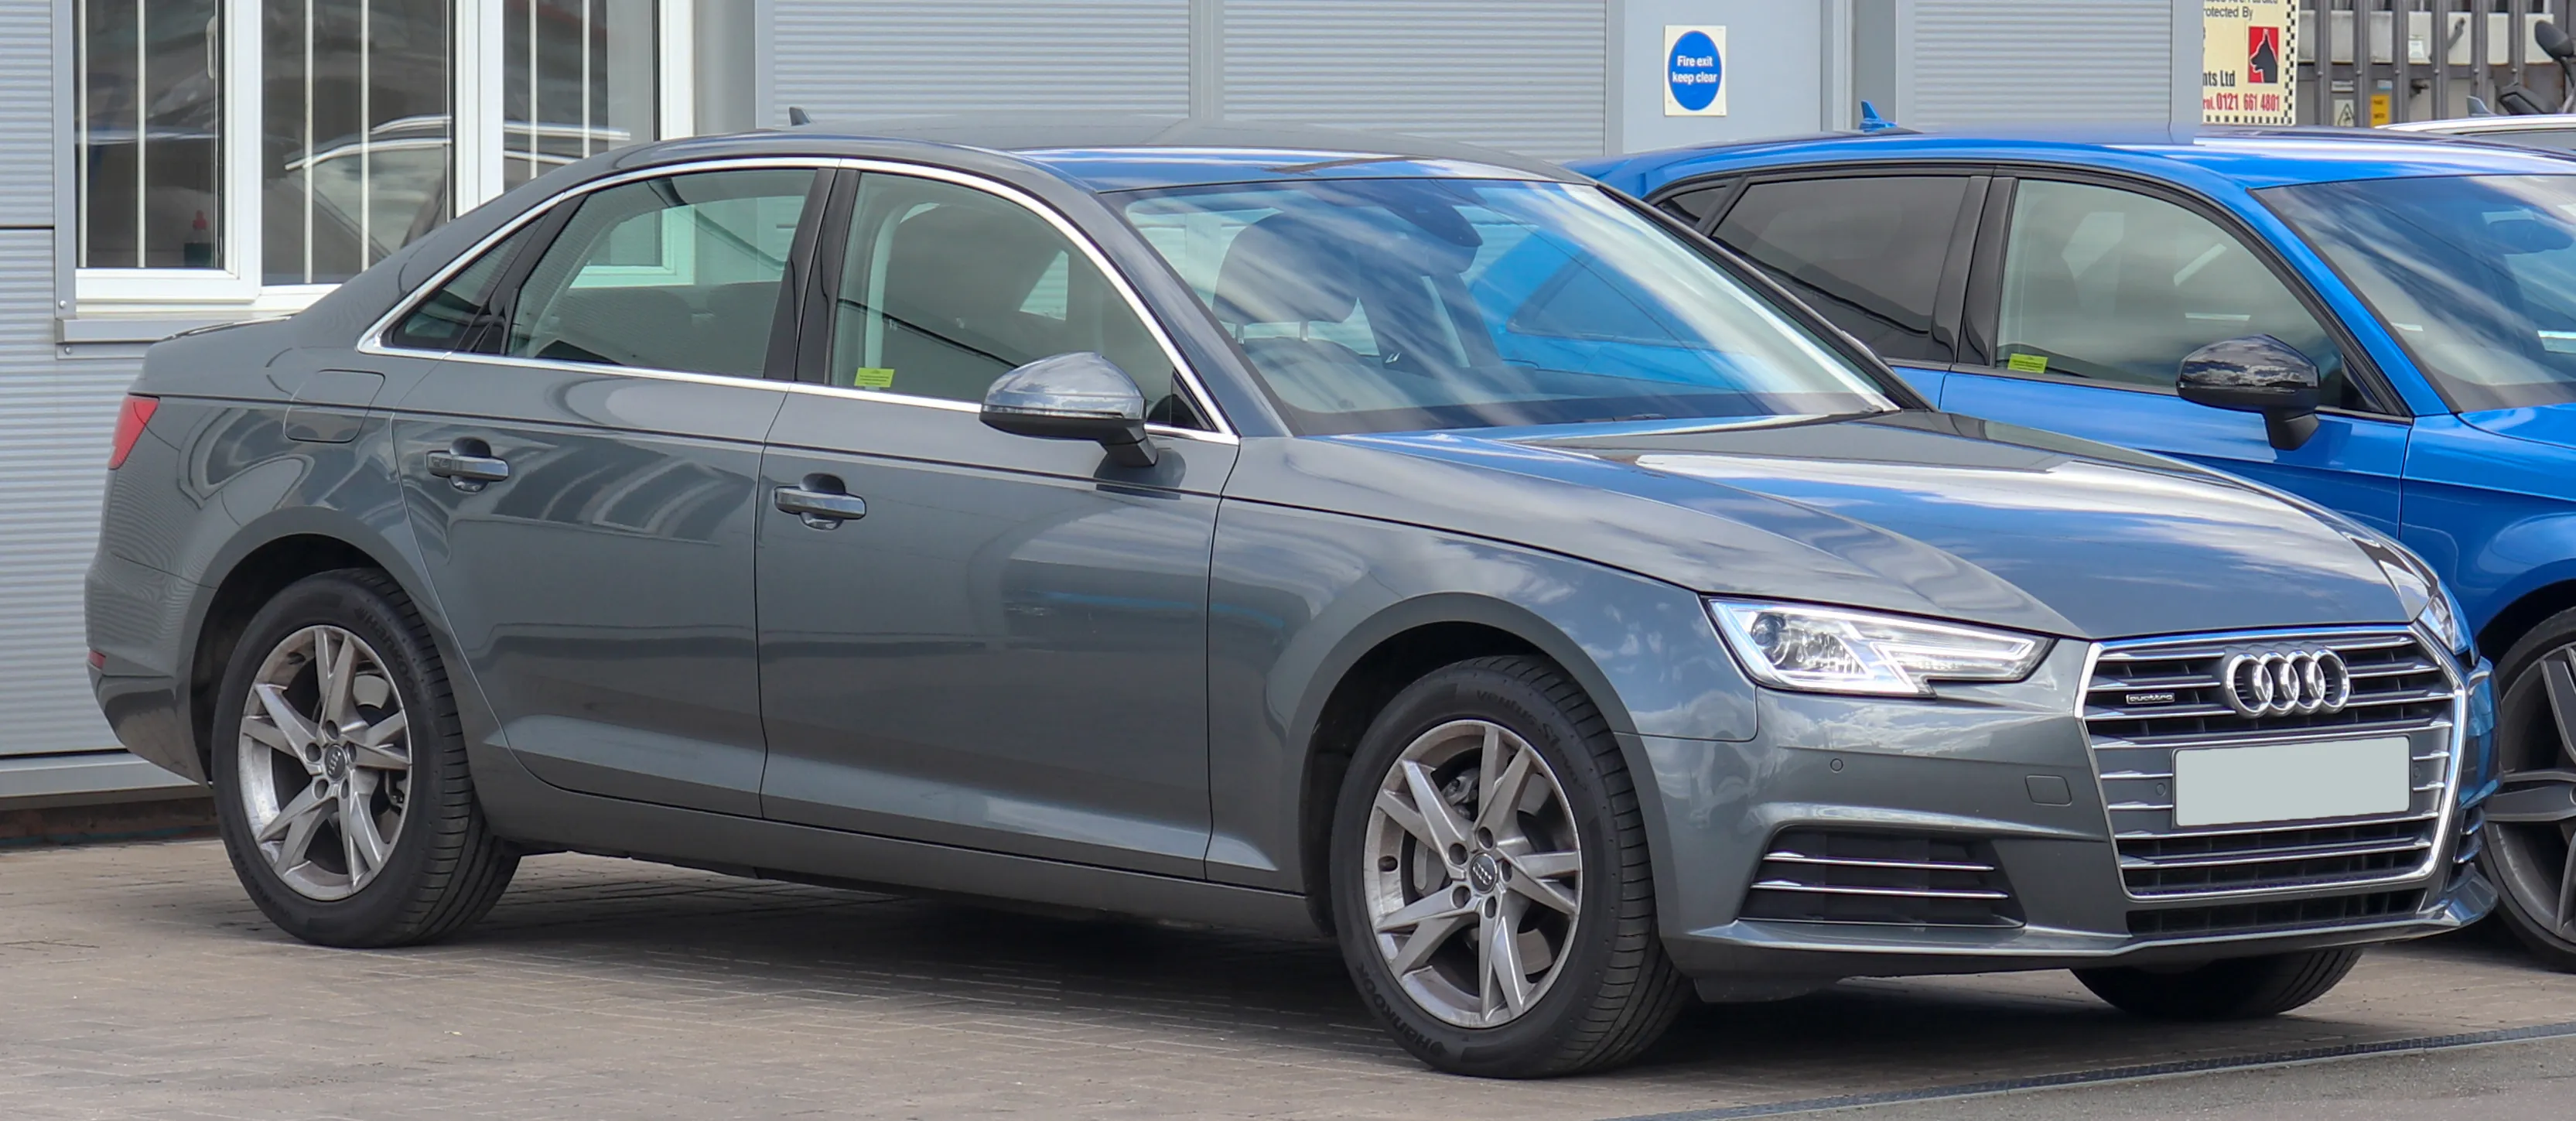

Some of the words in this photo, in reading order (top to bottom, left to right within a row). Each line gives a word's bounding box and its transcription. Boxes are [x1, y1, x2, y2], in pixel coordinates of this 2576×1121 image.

[2243, 6, 2253, 21] By
[1677, 55, 1695, 67] Fire
[1696, 56, 1713, 67] exit
[1672, 71, 1694, 85] keep
[1696, 71, 1717, 83] clear
[2220, 70, 2236, 87] Ltd
[2216, 93, 2239, 111] 0121
[2244, 94, 2257, 111] 661
[2261, 94, 2280, 111] 4801
